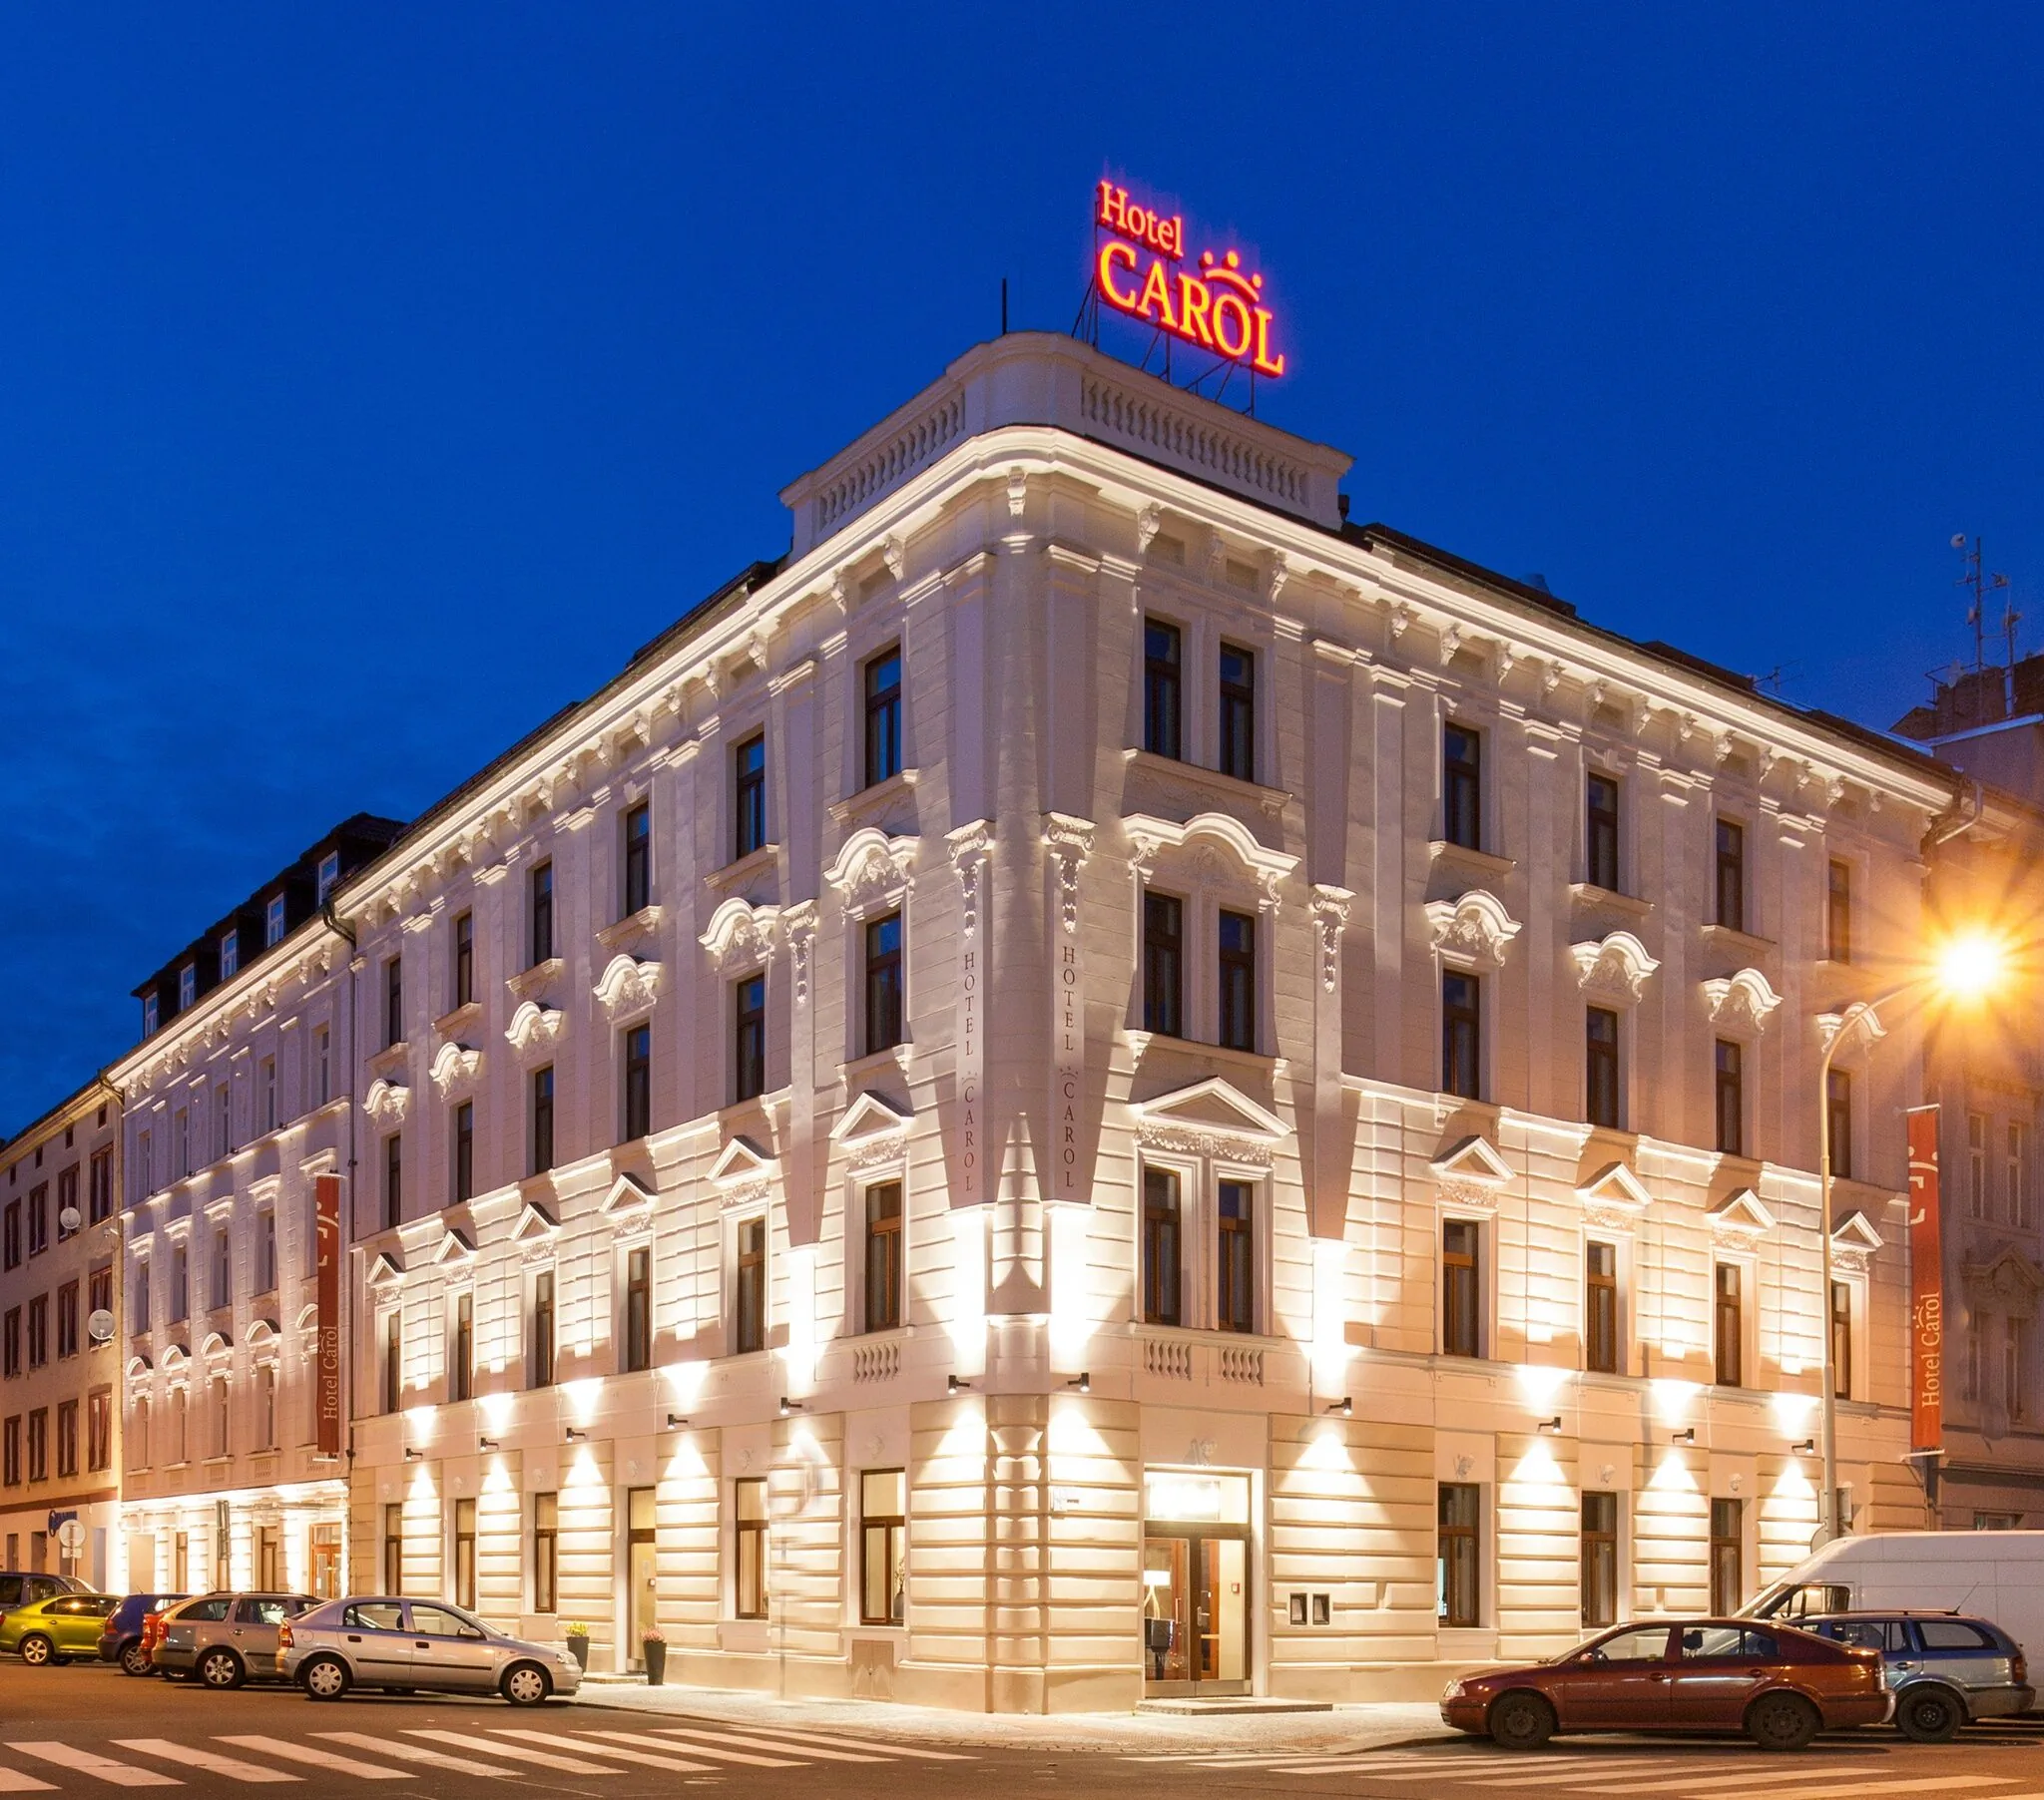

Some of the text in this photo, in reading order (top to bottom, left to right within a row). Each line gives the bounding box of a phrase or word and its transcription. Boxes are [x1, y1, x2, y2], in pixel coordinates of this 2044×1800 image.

[1100, 180, 1184, 258] Hotel
[1099, 241, 1284, 376] CAROL
[964, 951, 975, 1192] HOTEL CAROL
[1062, 945, 1076, 1188] HOTEL CAROL
[322, 1325, 338, 1421] Hotel Carol
[1920, 1291, 1940, 1408] Hotel Carol
